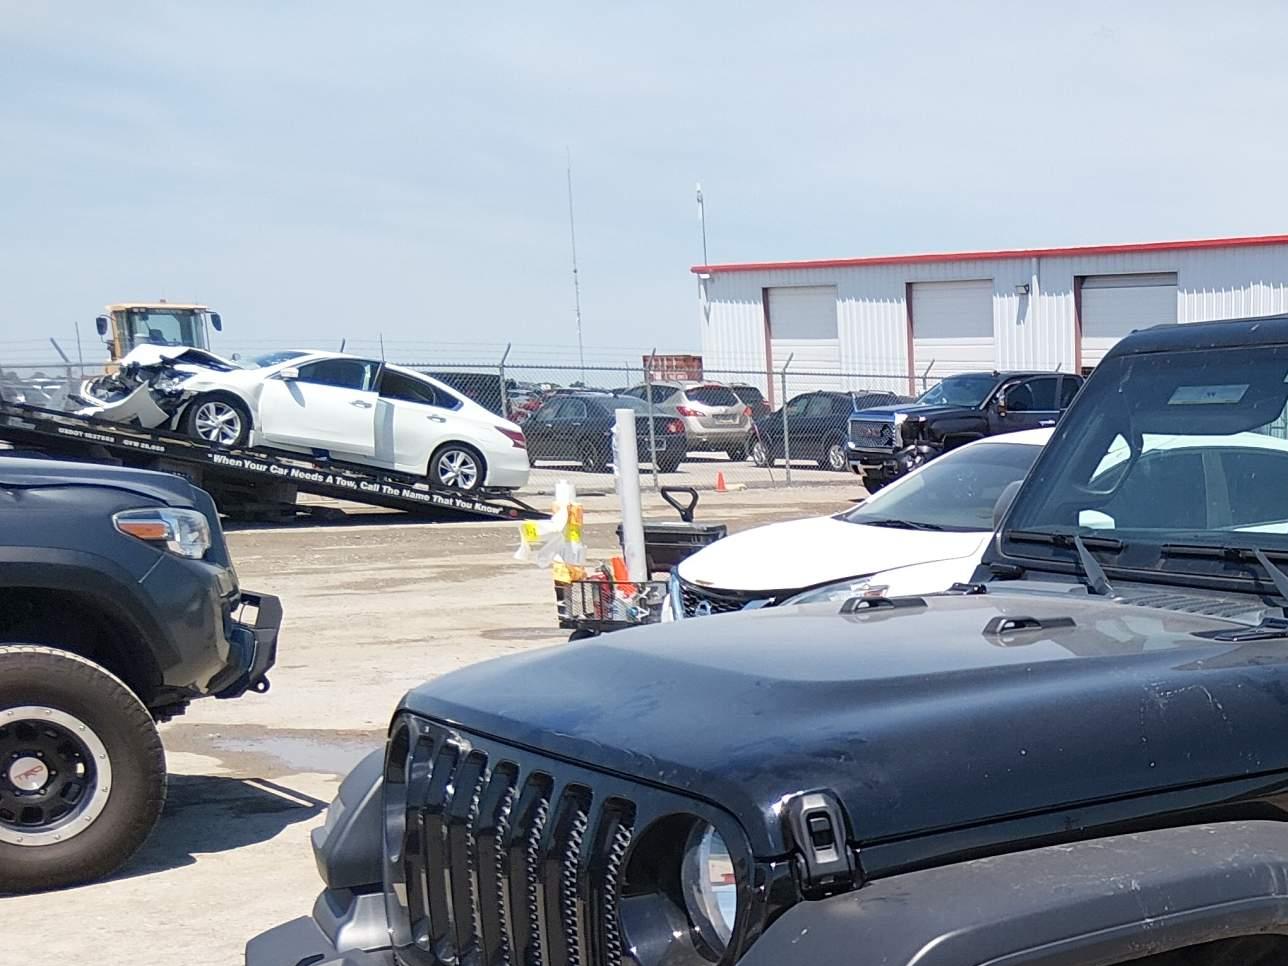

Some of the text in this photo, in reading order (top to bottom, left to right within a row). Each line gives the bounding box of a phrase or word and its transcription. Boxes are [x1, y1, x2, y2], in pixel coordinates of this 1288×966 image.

[244, 459, 268, 473] Your
[269, 464, 289, 475] Car
[290, 468, 323, 482] Needs
[325, 475, 334, 484] A
[335, 476, 358, 490] Tow,
[359, 481, 380, 492] Call
[381, 485, 401, 496] The
[401, 489, 431, 502] Name
[431, 494, 454, 506] That
[455, 498, 473, 510] You
